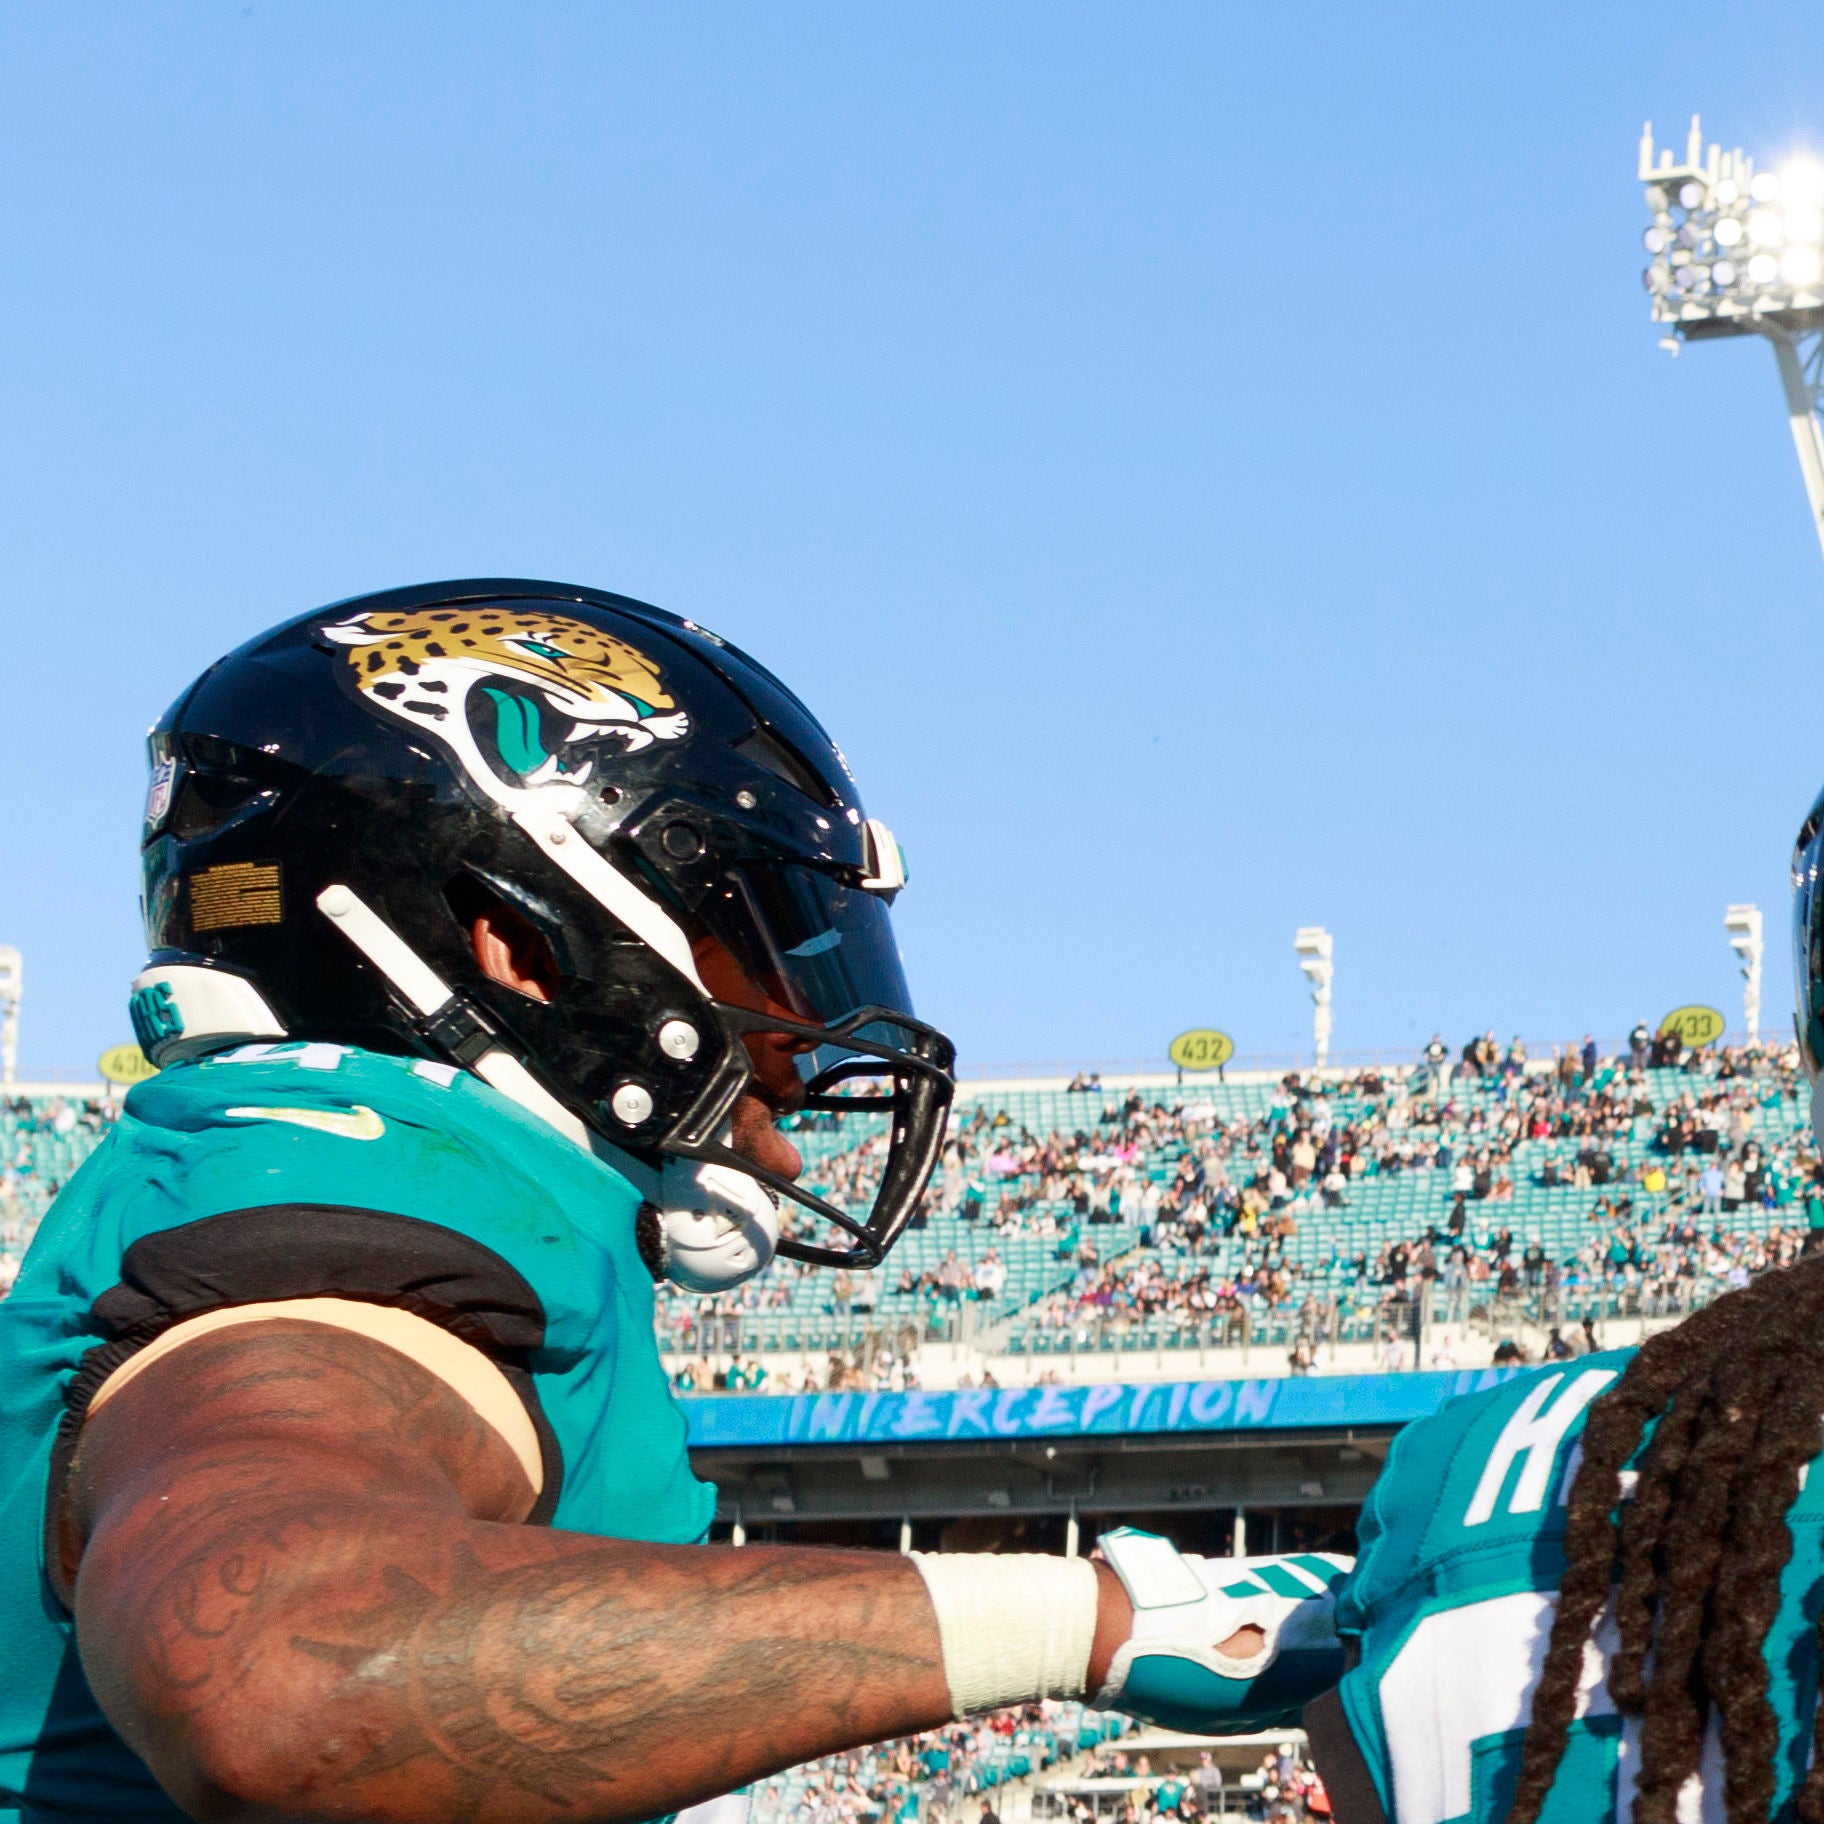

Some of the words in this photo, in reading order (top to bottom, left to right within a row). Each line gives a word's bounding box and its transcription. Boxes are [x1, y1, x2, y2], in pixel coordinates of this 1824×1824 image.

[1671, 1013, 1712, 1038] 433
[1179, 1038, 1222, 1061] 432
[789, 1378, 1283, 1441] INTERCEPTION
